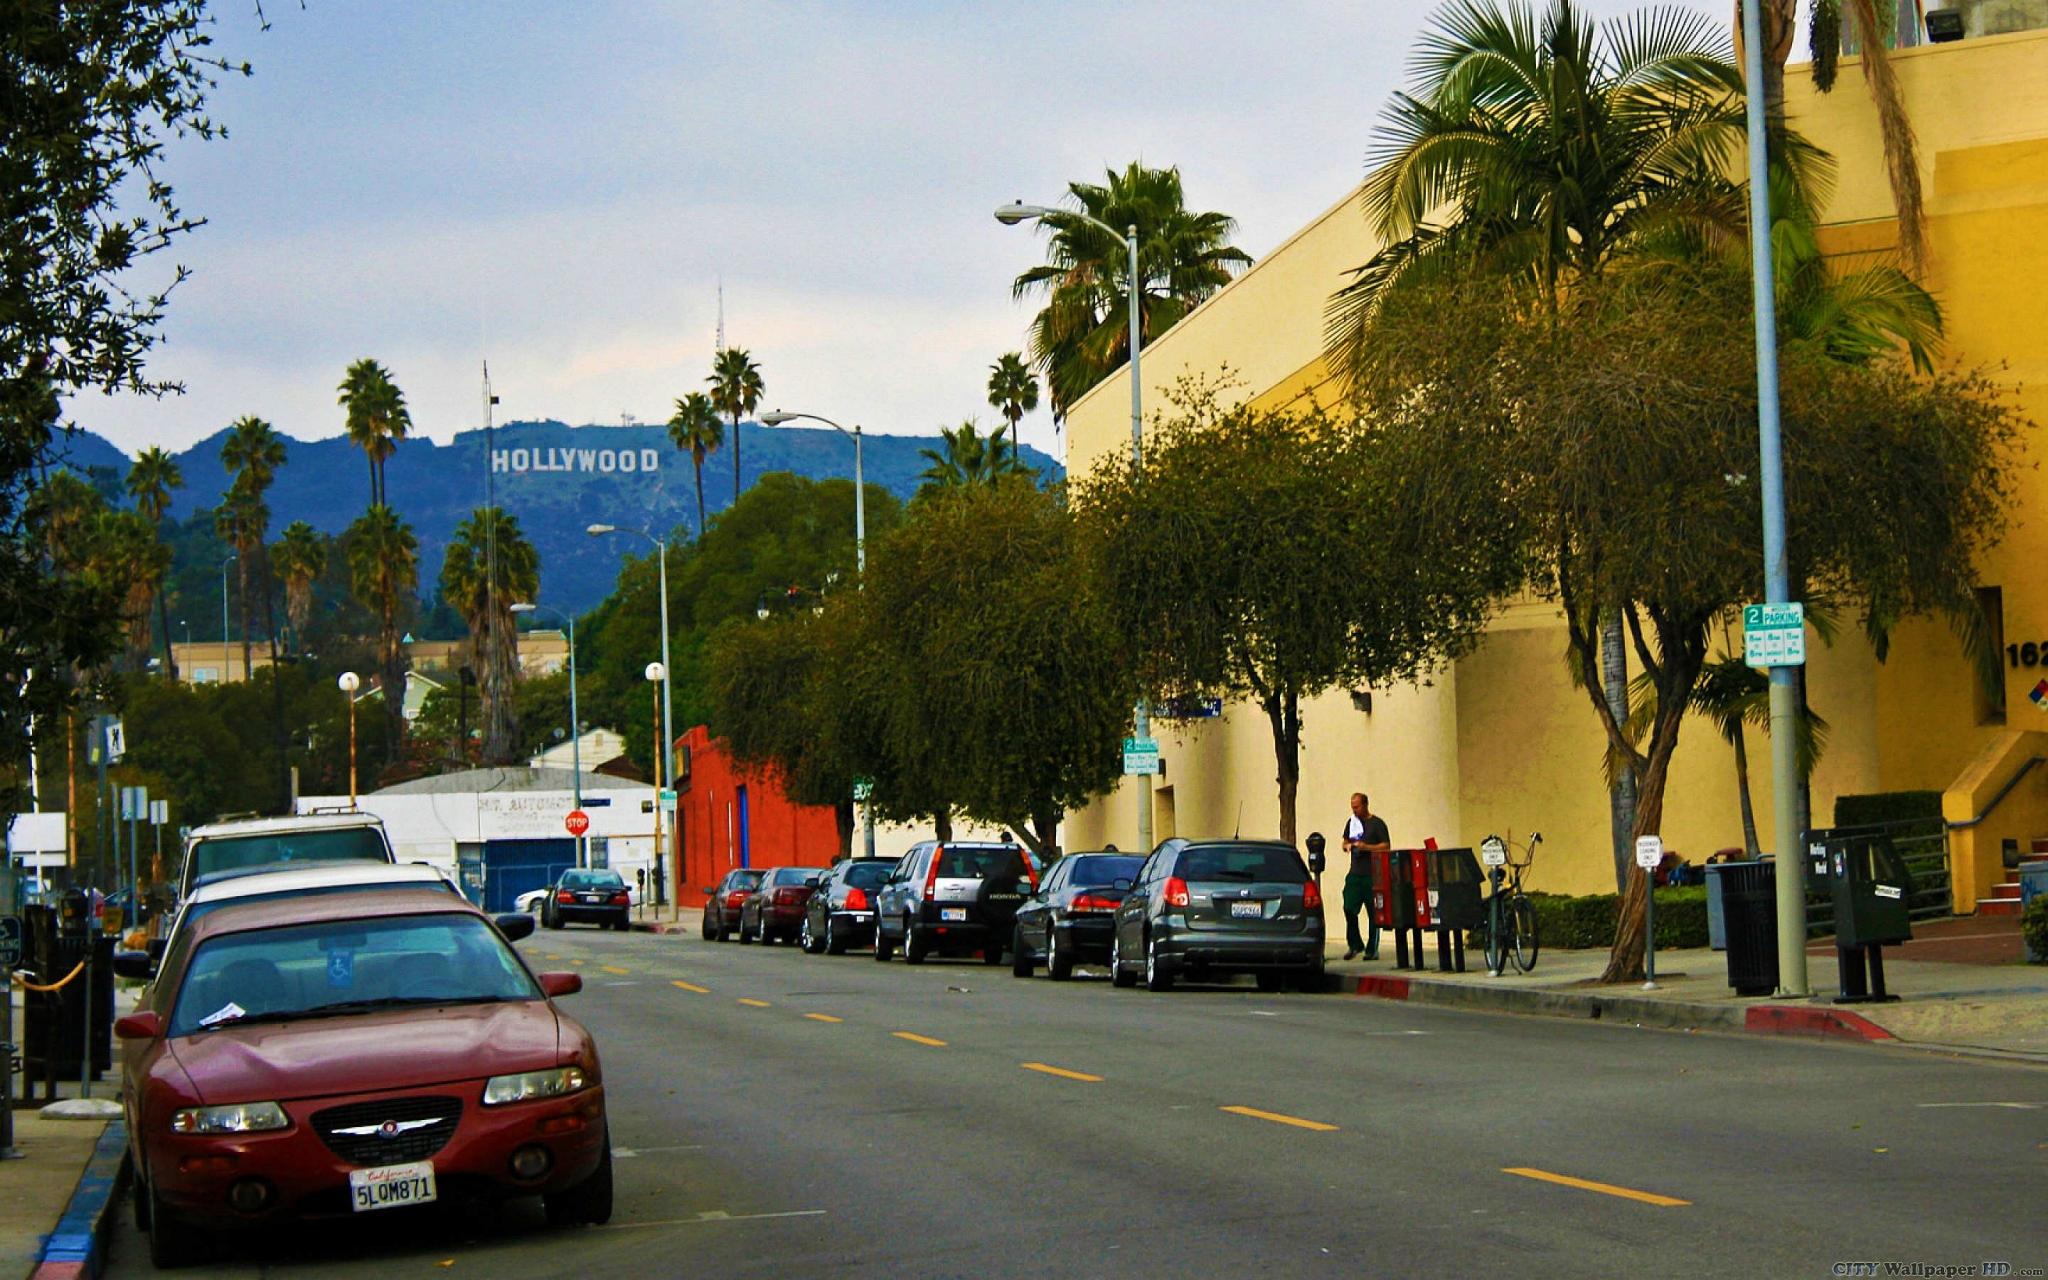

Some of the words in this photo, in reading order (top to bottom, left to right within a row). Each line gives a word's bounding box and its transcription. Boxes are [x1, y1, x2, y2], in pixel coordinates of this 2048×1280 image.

[492, 447, 658, 473] HOLLYWOOD
[1749, 608, 1759, 623] 2
[1764, 611, 1800, 624] PARKING
[1126, 740, 1134, 750] 2
[567, 817, 588, 828] STOP
